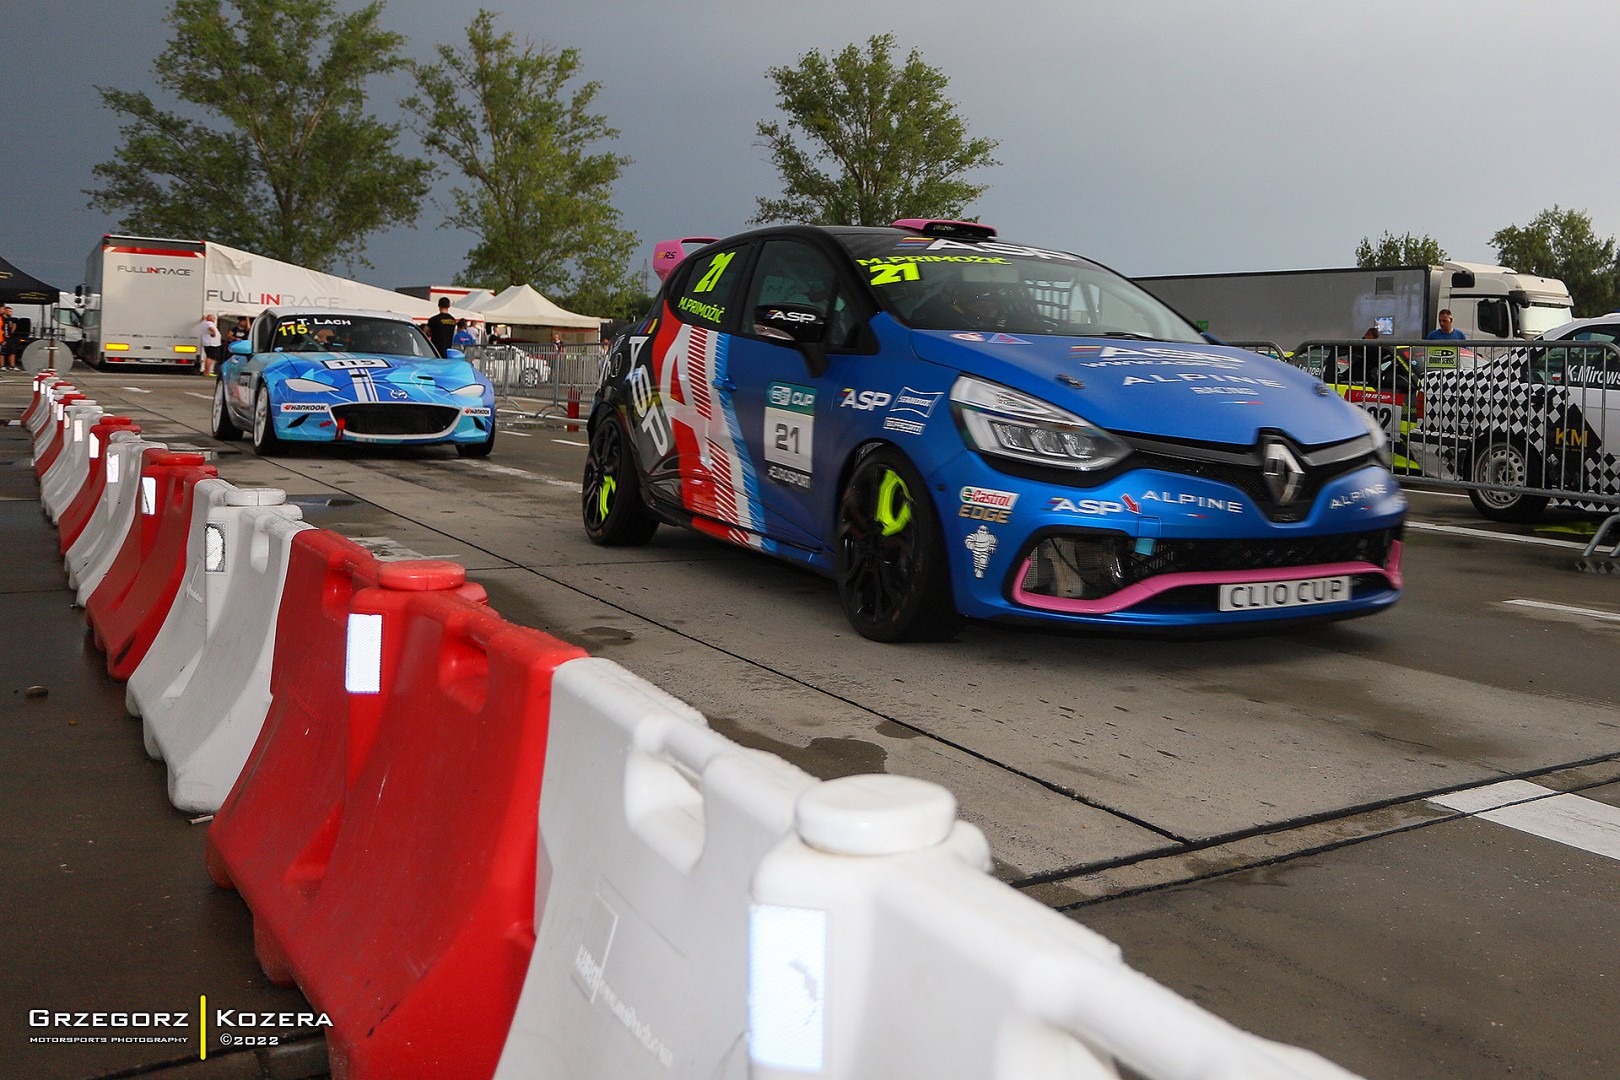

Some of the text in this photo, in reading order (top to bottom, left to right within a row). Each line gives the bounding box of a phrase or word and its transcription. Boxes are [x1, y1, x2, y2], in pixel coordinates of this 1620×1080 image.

[663, 251, 677, 259] RS
[693, 251, 737, 293] 21
[869, 262, 921, 286] 21
[770, 310, 817, 323] ASP
[278, 323, 309, 337] 115
[1123, 373, 1286, 389] ALPINE
[792, 391, 815, 407] CUP
[840, 388, 892, 411] ASP
[775, 423, 800, 455] 21
[1555, 427, 1589, 448] KM
[971, 490, 1013, 507] Castrol
[1141, 490, 1243, 514] ALPINE
[1330, 484, 1388, 509] ALPINE
[958, 504, 1013, 524] EDGE
[1051, 498, 1125, 517] ASP
[1230, 579, 1342, 608] CLIO CUP
